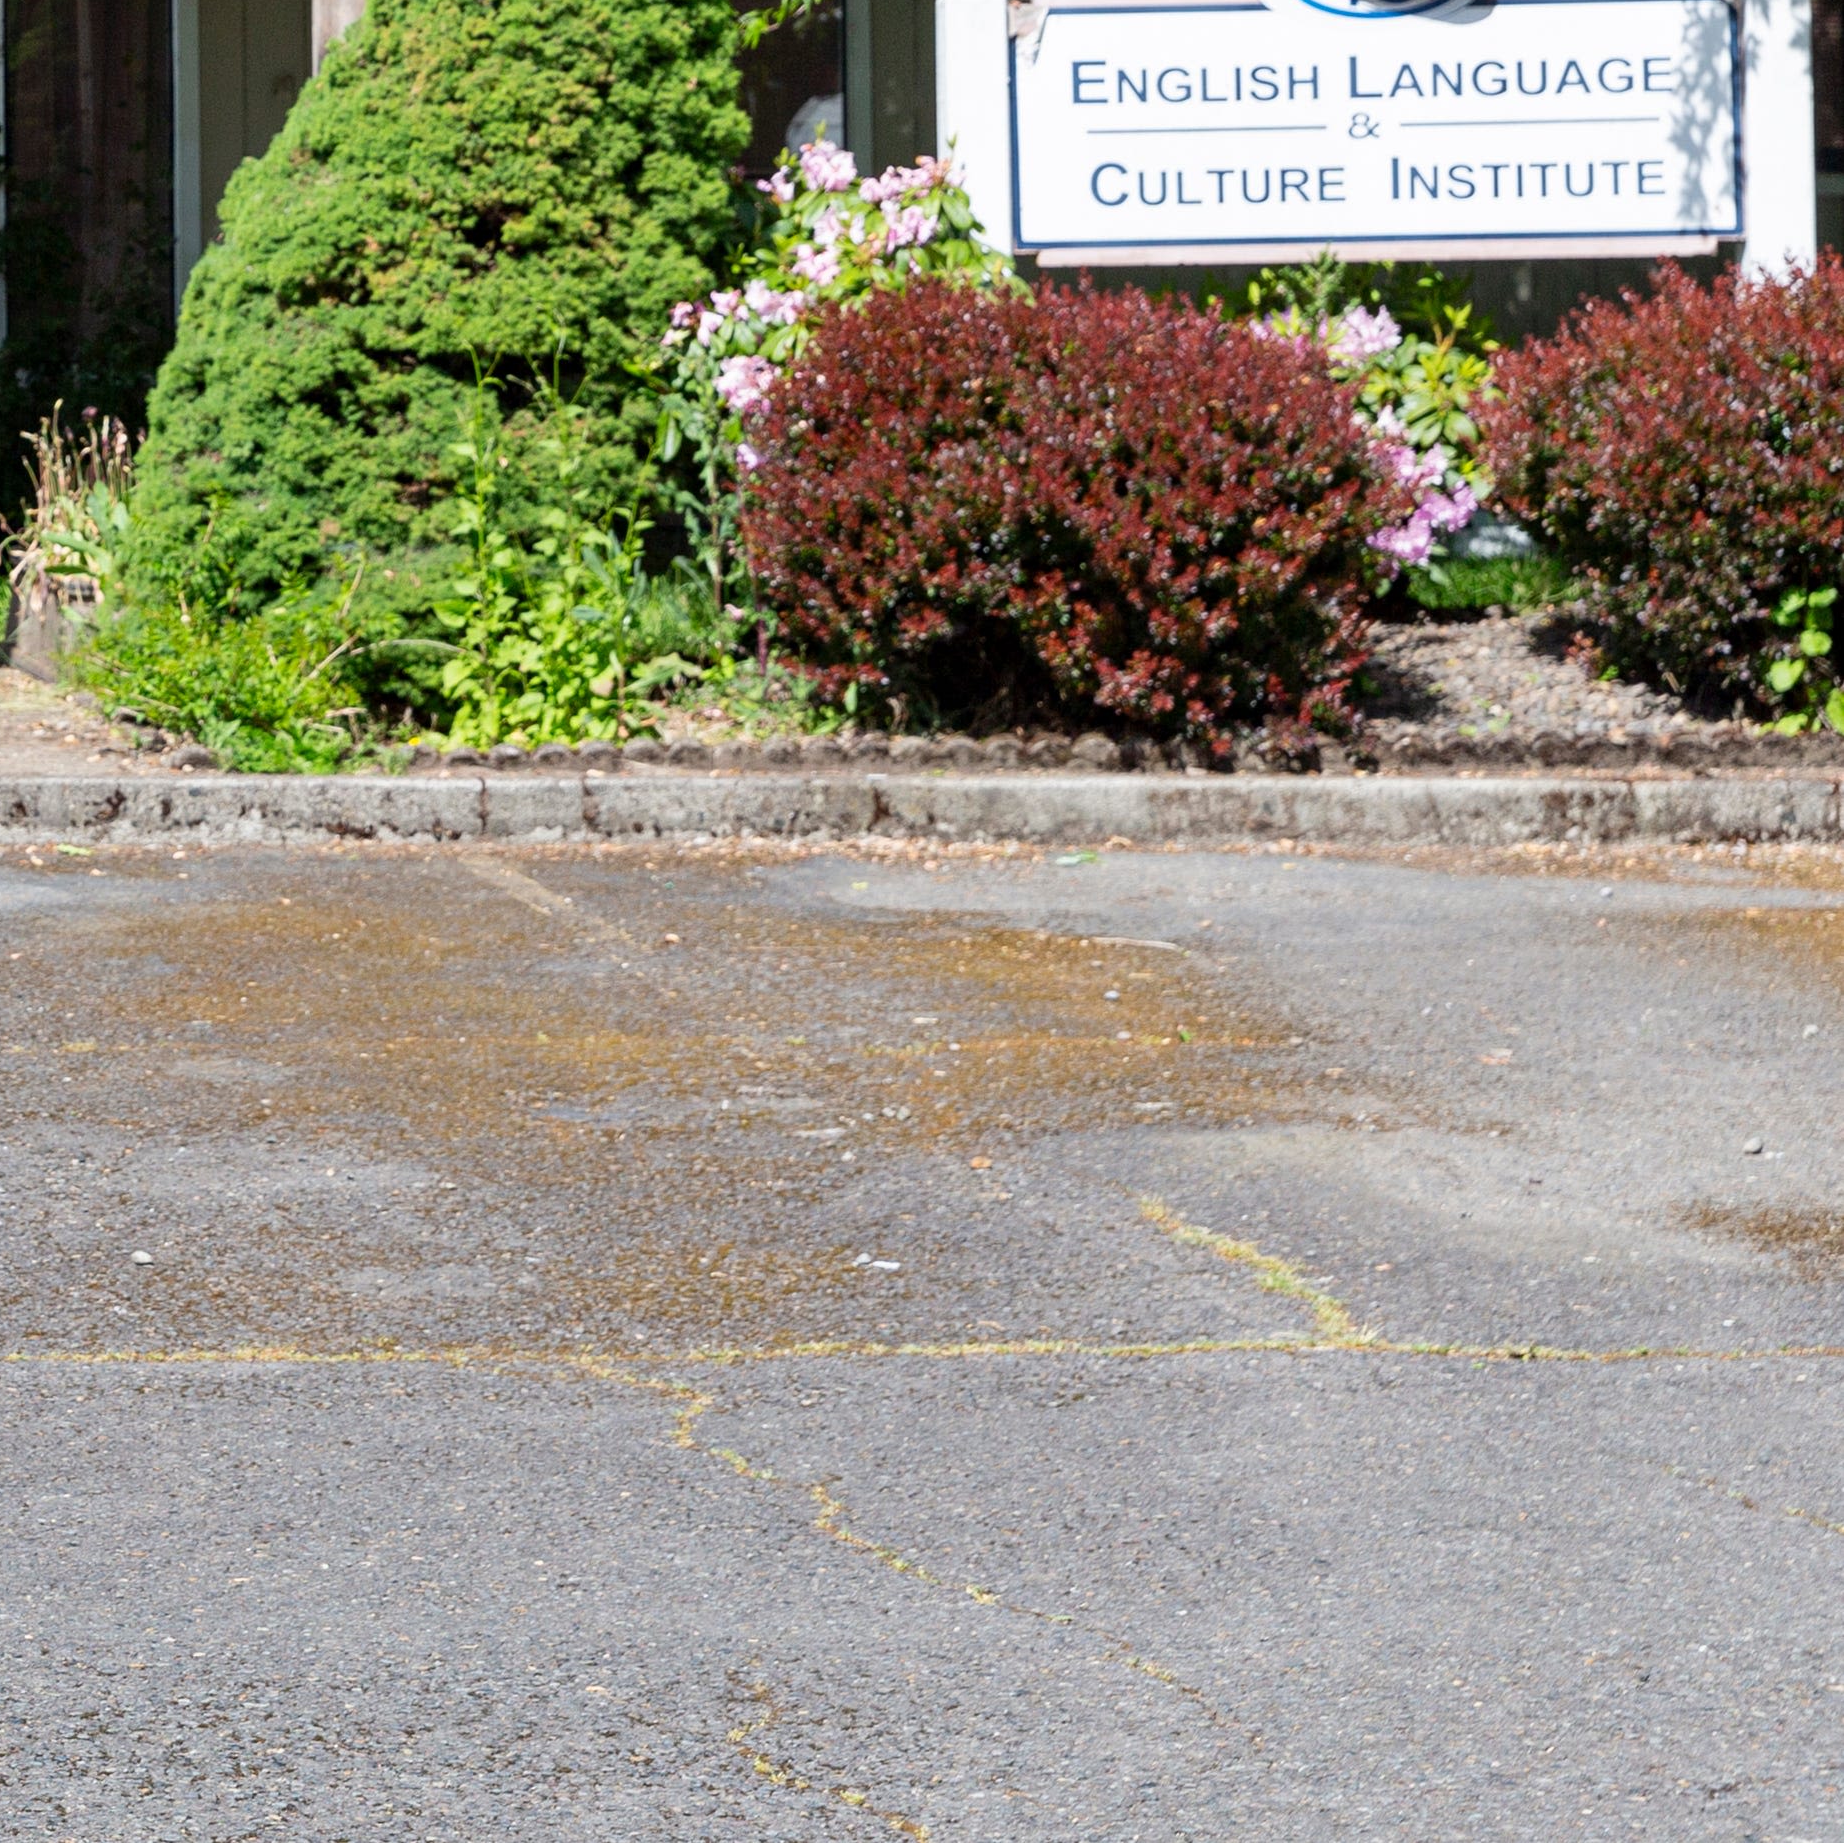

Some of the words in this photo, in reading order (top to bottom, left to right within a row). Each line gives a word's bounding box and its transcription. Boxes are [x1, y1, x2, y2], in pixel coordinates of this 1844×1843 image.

[1072, 60, 1319, 104] ENGLISH
[1348, 55, 1673, 99] LANGUAGE
[1348, 112, 1381, 140] &
[1090, 162, 1346, 206] CULTURE
[1391, 156, 1666, 200] INSTITUTE
